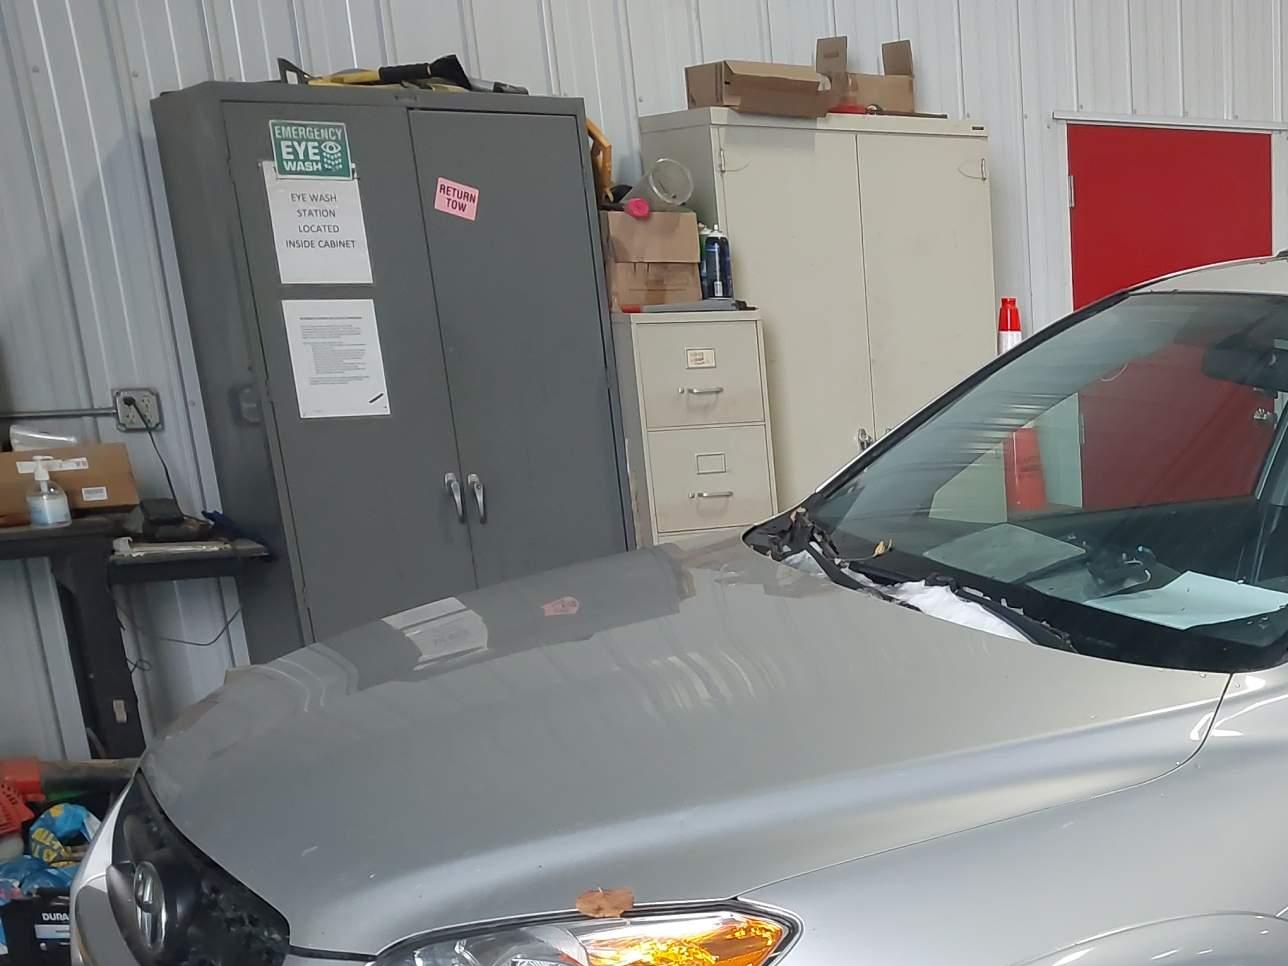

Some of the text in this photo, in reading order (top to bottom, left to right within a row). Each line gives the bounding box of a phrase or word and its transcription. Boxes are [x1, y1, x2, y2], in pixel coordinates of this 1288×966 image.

[275, 126, 342, 140] EMERGENCY
[280, 140, 320, 160] EYE
[282, 160, 322, 172] WASH
[290, 192, 337, 202] EYE WASH
[439, 184, 476, 203] RETURN
[446, 197, 467, 212] TOW
[296, 207, 336, 217] STATION
[298, 224, 340, 233] LOCATED
[285, 239, 356, 249] INSIDE CABINET
